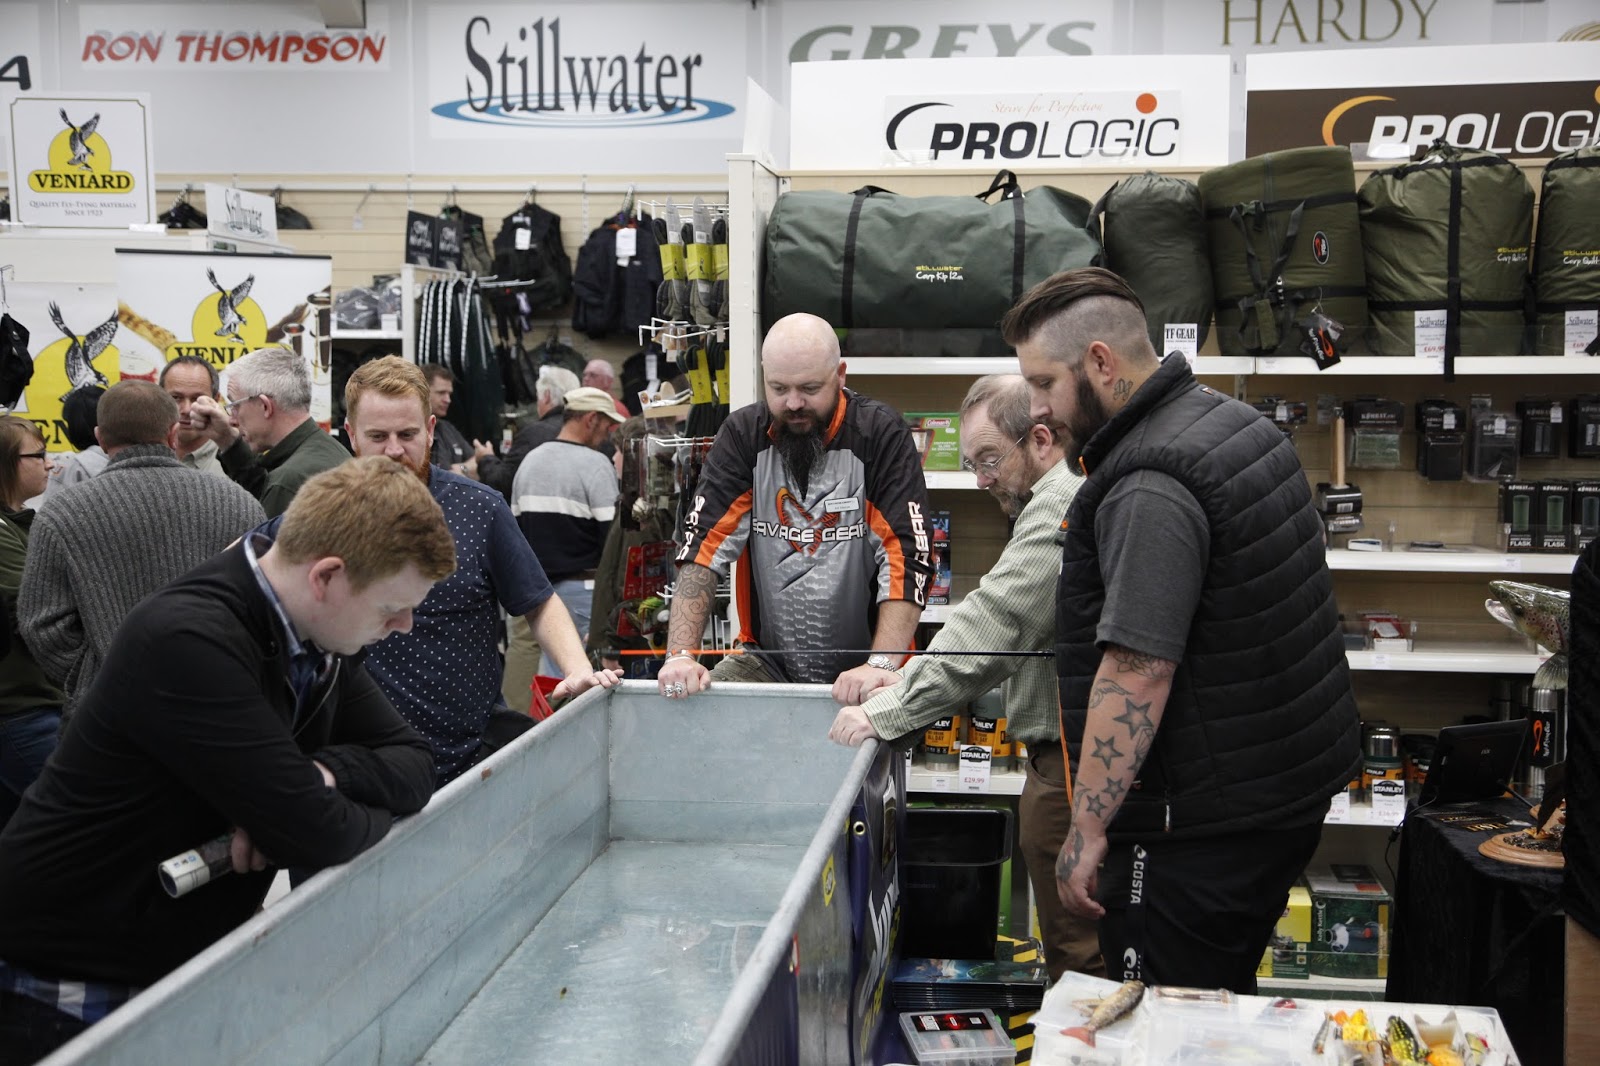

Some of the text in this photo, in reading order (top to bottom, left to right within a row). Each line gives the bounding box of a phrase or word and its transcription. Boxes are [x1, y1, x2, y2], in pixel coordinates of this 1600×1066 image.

[1220, 0, 1438, 46] HARDY
[82, 34, 386, 63] RON THOMPSON
[464, 15, 703, 113] Stillwater
[930, 116, 1180, 161] PROLOGIC
[1367, 109, 1600, 159] PROLOGI
[34, 173, 131, 189] VENIARD
[1166, 328, 1195, 339] TF GEAR
[174, 347, 264, 364] VENIA
[961, 751, 991, 759] STANLEY
[964, 776, 985, 784] £29.99
[1373, 785, 1404, 793] STANLEY
[1130, 860, 1145, 904] COSTA
